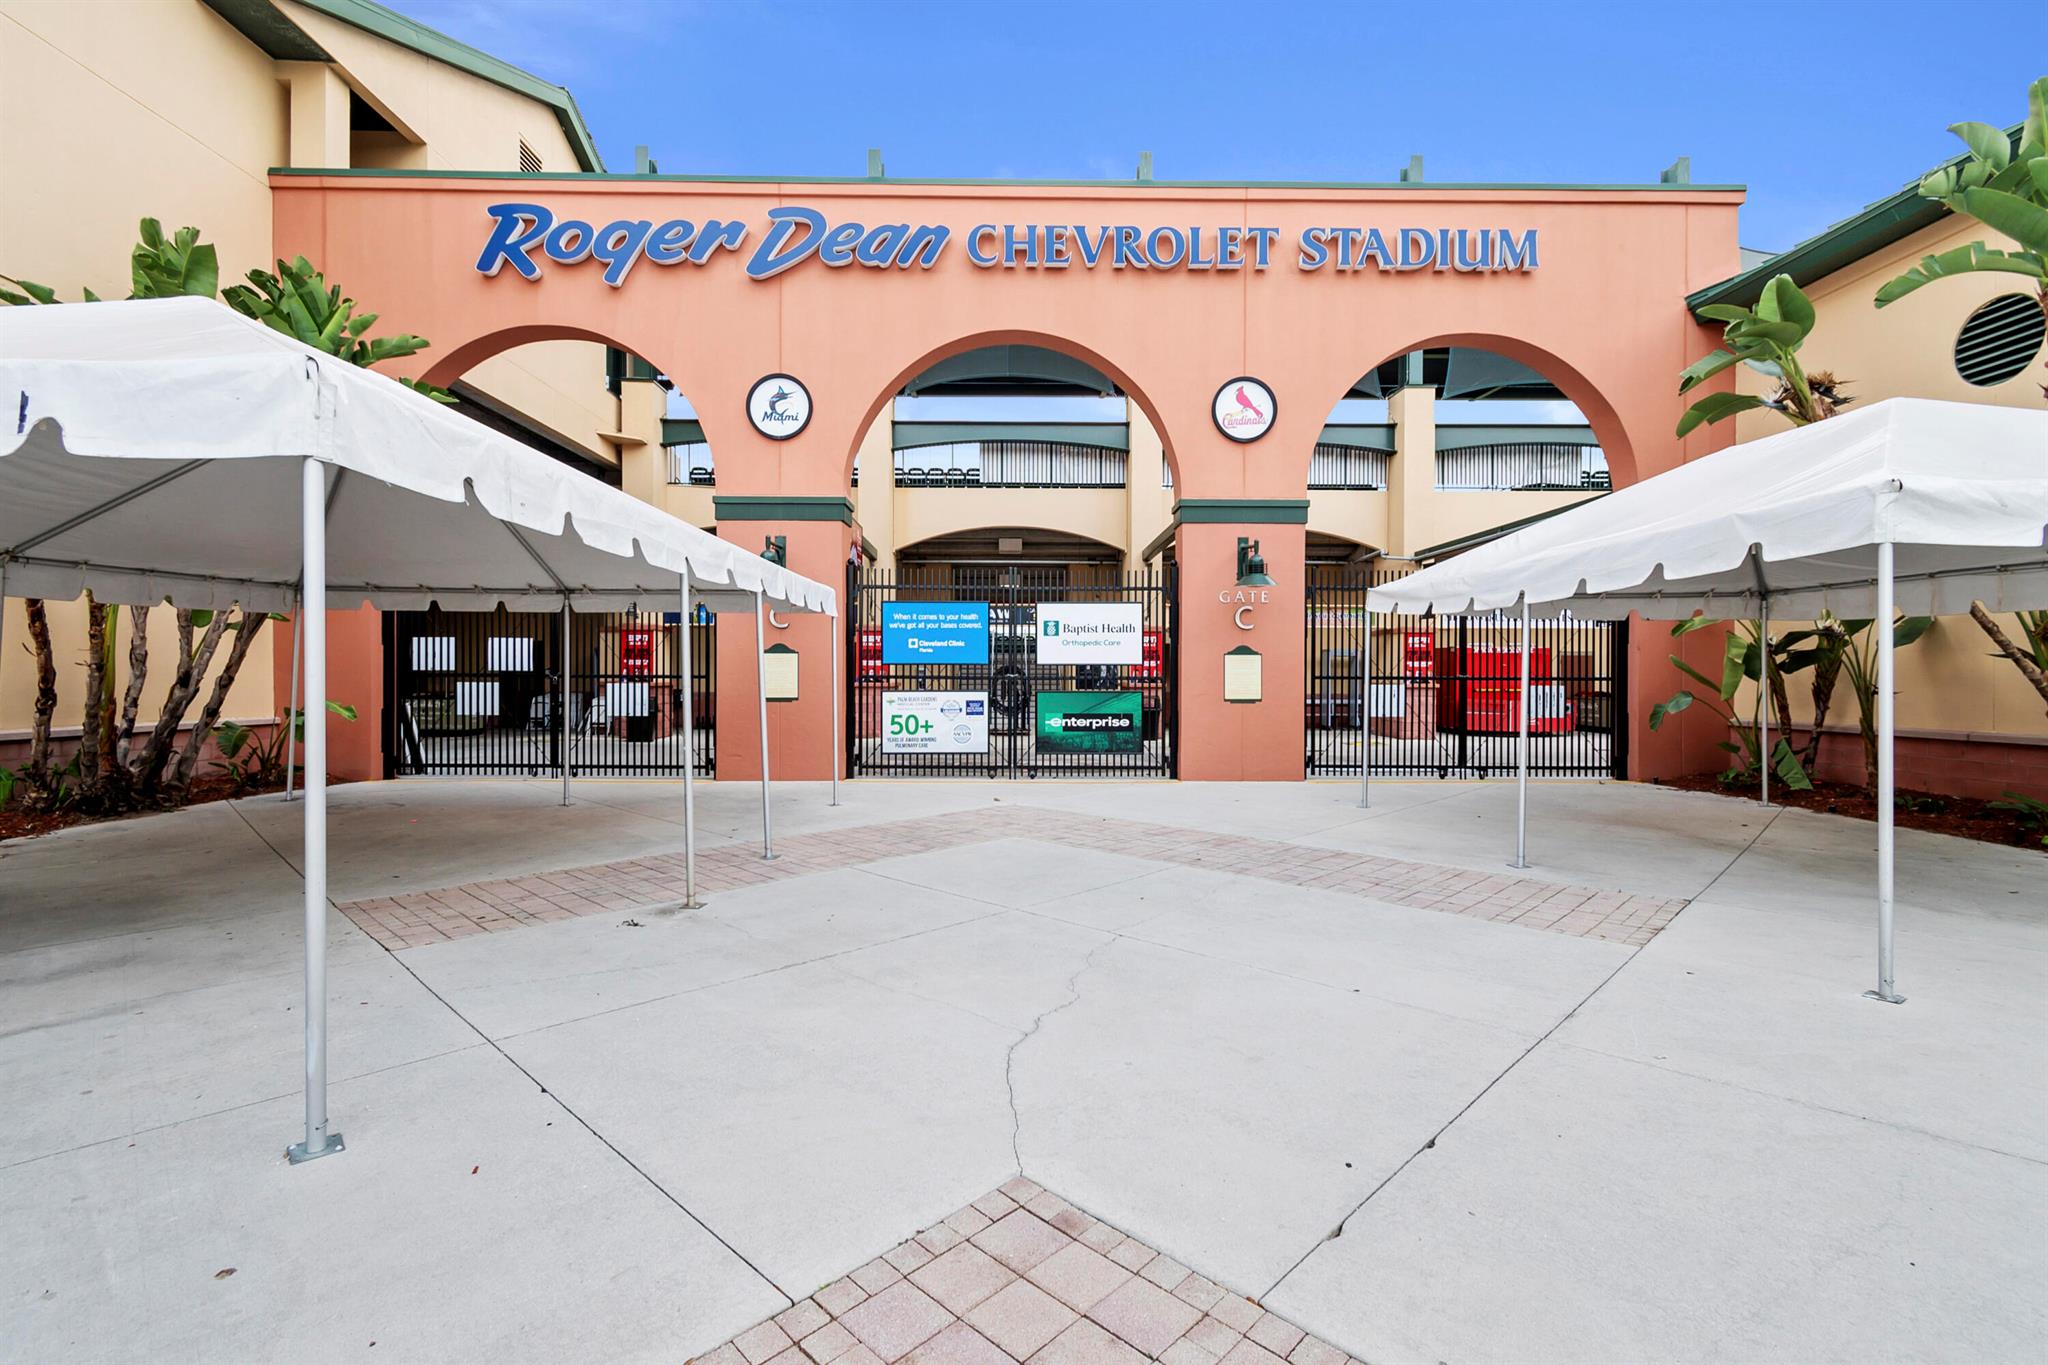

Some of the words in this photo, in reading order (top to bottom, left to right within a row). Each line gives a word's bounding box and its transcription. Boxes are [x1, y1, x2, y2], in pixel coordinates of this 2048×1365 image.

[475, 203, 749, 288] Roger
[745, 206, 951, 280] Dean
[966, 224, 1279, 270] CHEVROLET
[1299, 227, 1540, 272] STADIUM
[762, 411, 799, 423] Miami
[1219, 590, 1270, 603] GATE
[1234, 605, 1255, 630] C
[1063, 623, 1098, 635] Baptist
[1102, 623, 1136, 633] Health
[1062, 639, 1101, 648] Orthopedic
[890, 714, 934, 735] 50+
[1045, 716, 1130, 729] enterprise
